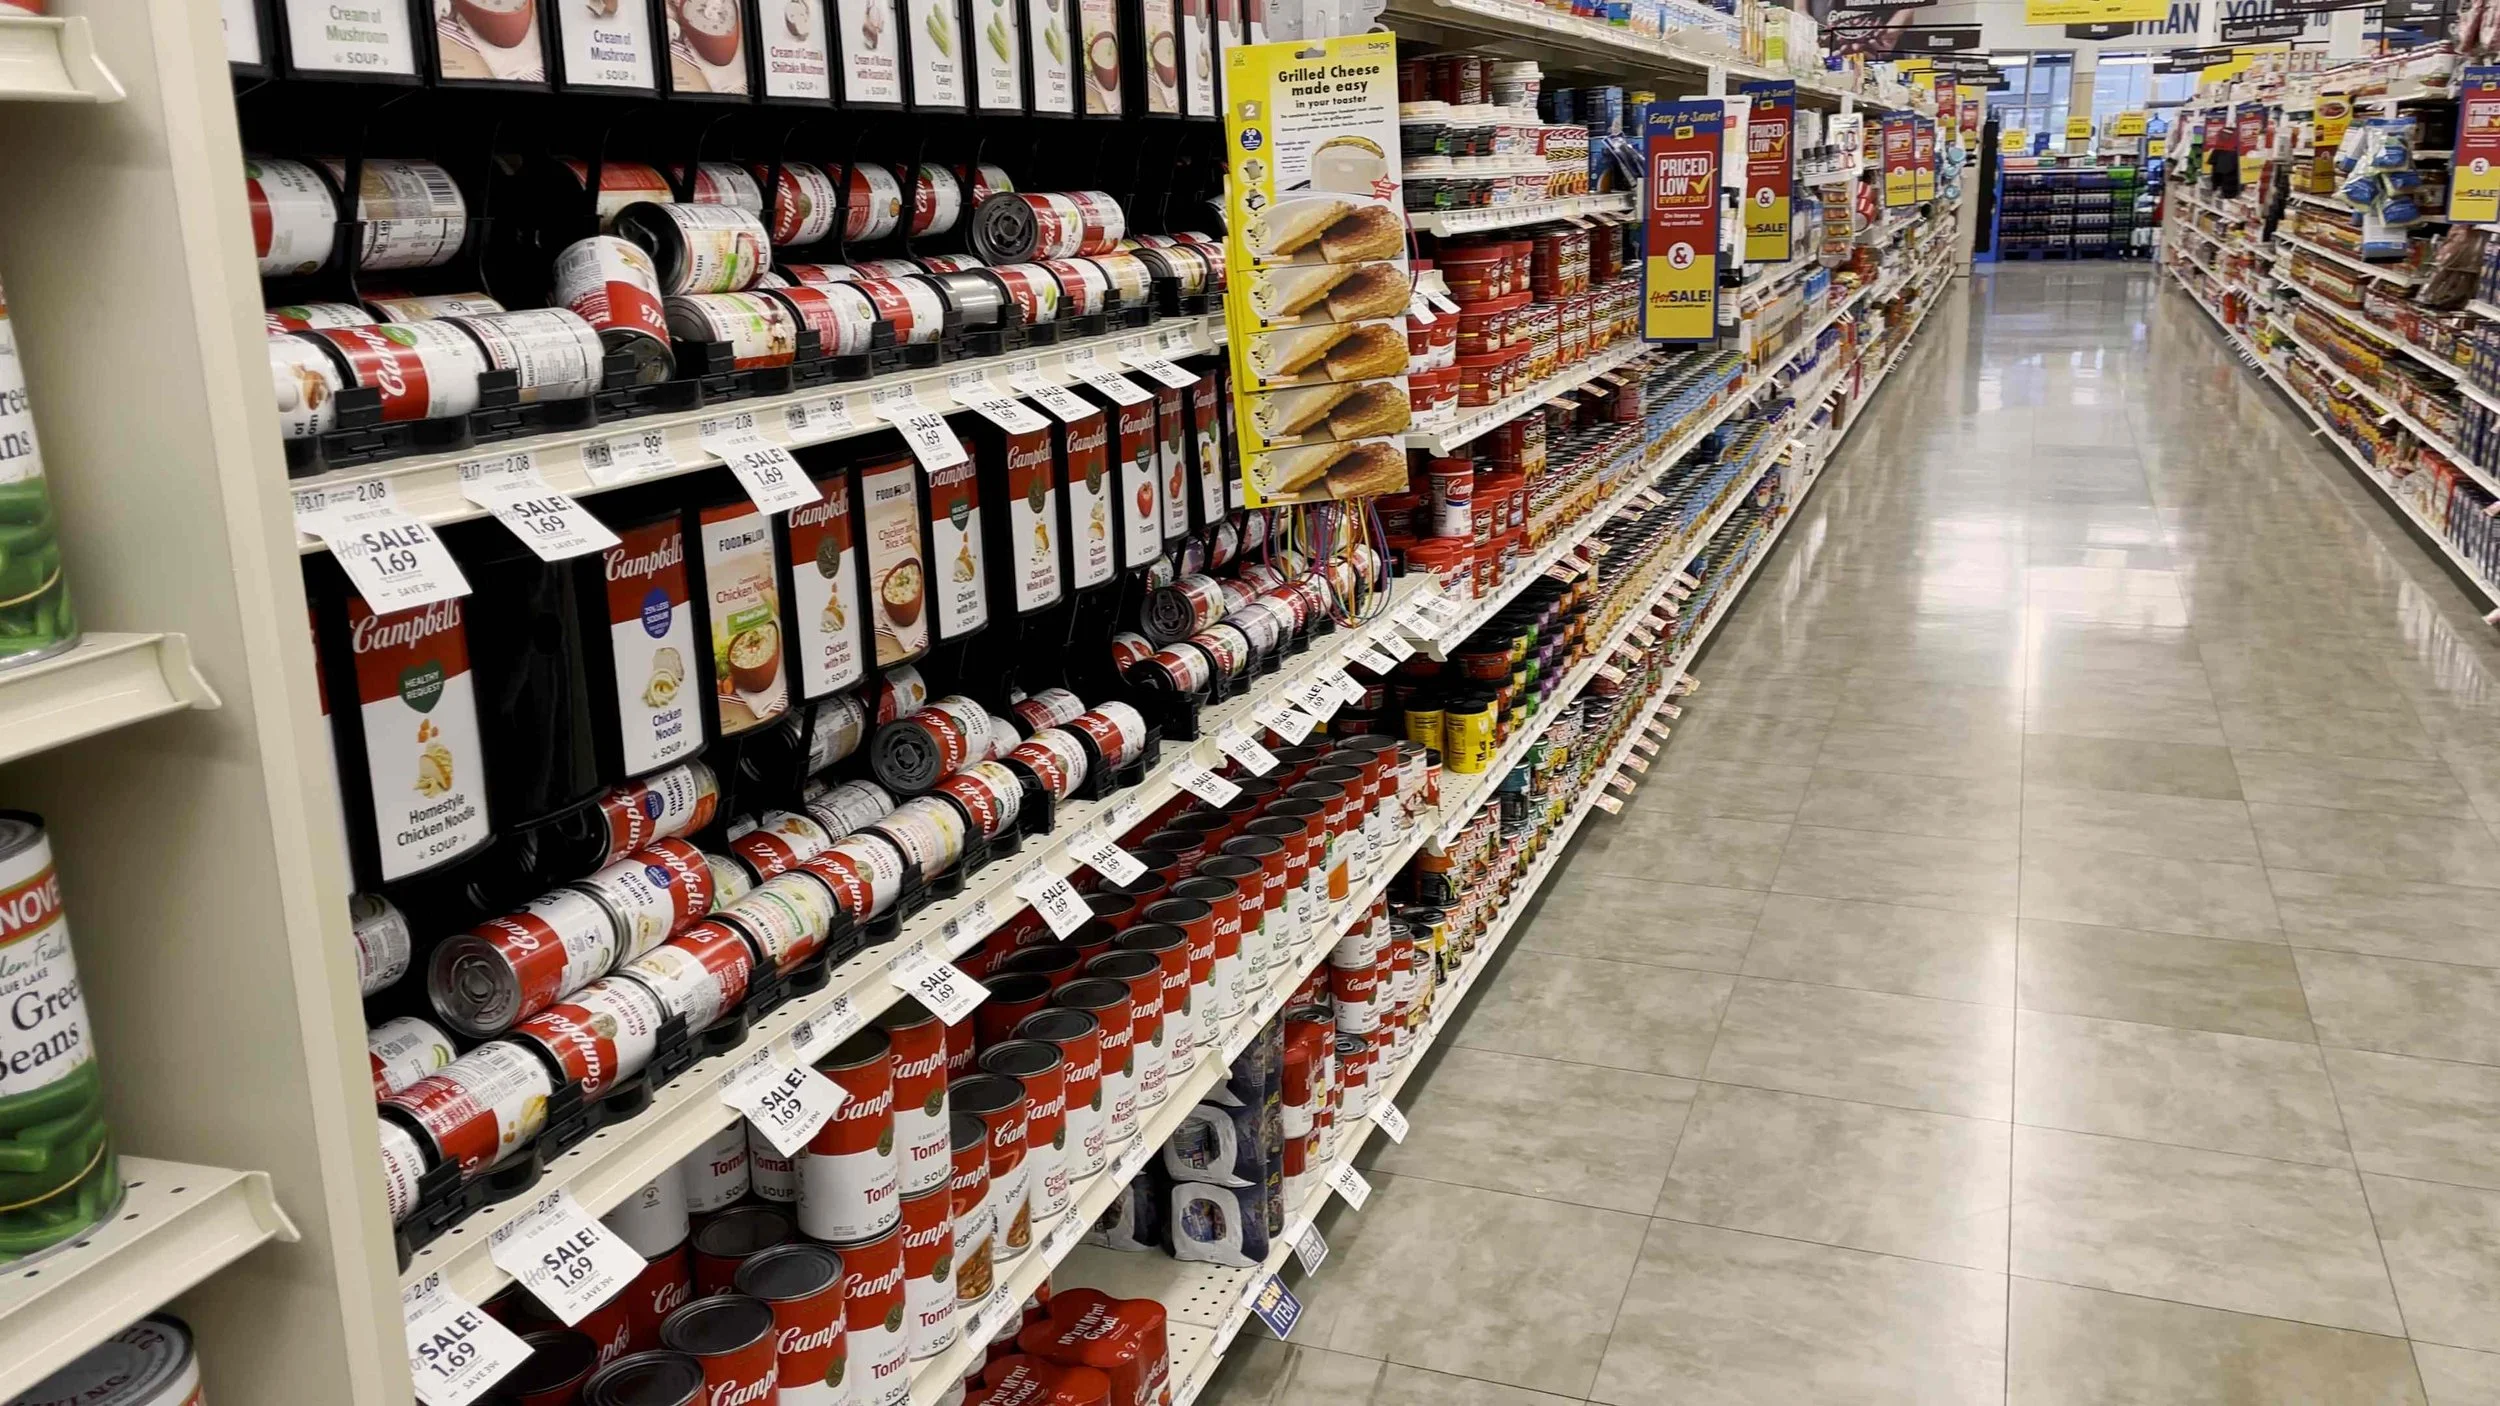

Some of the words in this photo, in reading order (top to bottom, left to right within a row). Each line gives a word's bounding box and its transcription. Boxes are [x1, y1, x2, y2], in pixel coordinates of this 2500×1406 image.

[330, 5, 371, 21] Cream
[326, 25, 389, 44] Mushroom
[594, 30, 623, 44] Cream
[591, 47, 636, 63] Mushroom
[771, 47, 794, 58] Cream
[1369, 41, 1390, 51] bags
[347, 52, 379, 64] SOUP
[605, 69, 629, 80] SOUP
[1278, 64, 1325, 83] Grilled
[1331, 64, 1380, 78] Cheese
[796, 81, 813, 90] SOUP
[1291, 81, 1330, 96] made
[1336, 80, 1368, 94] easy
[1245, 105, 1256, 117] 2
[1296, 99, 1305, 109] in
[1308, 98, 1330, 109] your
[1333, 94, 1367, 105] toaster
[1650, 113, 1676, 129] Easy
[1677, 112, 1688, 122] to
[1691, 111, 1721, 123] Save!
[1750, 124, 1784, 137] PRICED
[1750, 139, 1770, 152] LOW
[1660, 157, 1707, 177] PRICED
[1660, 178, 1688, 196] LOW
[1659, 196, 1686, 204] EVERY
[1688, 195, 1706, 203] DAY
[1760, 191, 1770, 204] &
[1673, 247, 1687, 264] &
[1670, 289, 1711, 303] SALE!
[983, 398, 1015, 411] SALE!
[735, 414, 752, 430] 2.08
[910, 413, 942, 431] SALE!
[917, 430, 940, 446] 1.69
[507, 456, 530, 473] 2.08
[744, 448, 788, 469] SALE!
[754, 467, 783, 486] 1.69
[357, 482, 386, 502] 2.08
[876, 487, 894, 500] FOOD
[513, 495, 573, 518] SALE!
[524, 516, 565, 535] 1.69
[878, 526, 906, 541] Chicken
[362, 524, 431, 553] SALE!
[719, 535, 741, 551] FOOD
[885, 538, 899, 549] Rice
[371, 550, 417, 576] 1.69
[398, 583, 421, 597] SAVE
[716, 586, 751, 604] Chicken
[957, 590, 976, 604] Chicken
[825, 640, 848, 656] Chicken
[824, 656, 839, 670] with
[839, 652, 851, 664] Rice
[404, 671, 439, 688] HEALTHY
[831, 670, 848, 682] SOUP
[406, 681, 441, 699] REQUEST
[653, 707, 682, 727] Chicken
[1272, 710, 1291, 726] SALE!
[655, 722, 682, 741] Noodle
[661, 740, 681, 757] SOUP
[1192, 771, 1214, 787] SALE!
[663, 777, 677, 817] Chicken
[672, 776, 684, 812] Noodle
[409, 793, 465, 824] Homestyle
[397, 821, 444, 846] Chicken
[445, 806, 475, 830] Noodle
[429, 835, 458, 856] SOUP
[1092, 844, 1118, 863] SALE!
[1101, 860, 1120, 873] 1.69
[618, 877, 645, 906] Noodle
[624, 872, 653, 904] Chicken
[1042, 879, 1069, 904] SALE!
[1049, 898, 1068, 916] 1.69
[35, 932, 68, 967] Fresh
[23, 967, 49, 986] LAKE
[920, 965, 955, 992] SALE!
[930, 984, 955, 1004] 1.69
[609, 988, 648, 1036] Mushroom
[617, 1004, 638, 1036] Cream
[761, 1067, 807, 1111] SALE!
[770, 1099, 802, 1126] 1.69
[924, 1164, 948, 1185] SOUP
[762, 1186, 794, 1197] SOUP
[538, 1189, 560, 1215] 2.08
[544, 1226, 600, 1271] SALE!
[1305, 1240, 1324, 1267] ITEM
[553, 1256, 593, 1289] 1.69
[413, 1272, 439, 1300] 2.08
[581, 1284, 600, 1303] SAVE
[1257, 1281, 1283, 1314] NEW
[1271, 1295, 1297, 1329] ITEM
[1057, 1323, 1092, 1345] M'm!
[1082, 1303, 1107, 1324] M'm!
[1083, 1315, 1119, 1340] Good!
[418, 1310, 483, 1362] SALE!
[430, 1341, 476, 1378] 1.69
[462, 1371, 485, 1391] SAVE
[486, 1359, 500, 1374] 39¢
[1000, 1365, 1030, 1389] M'm!
[1002, 1380, 1040, 1406] Good!
